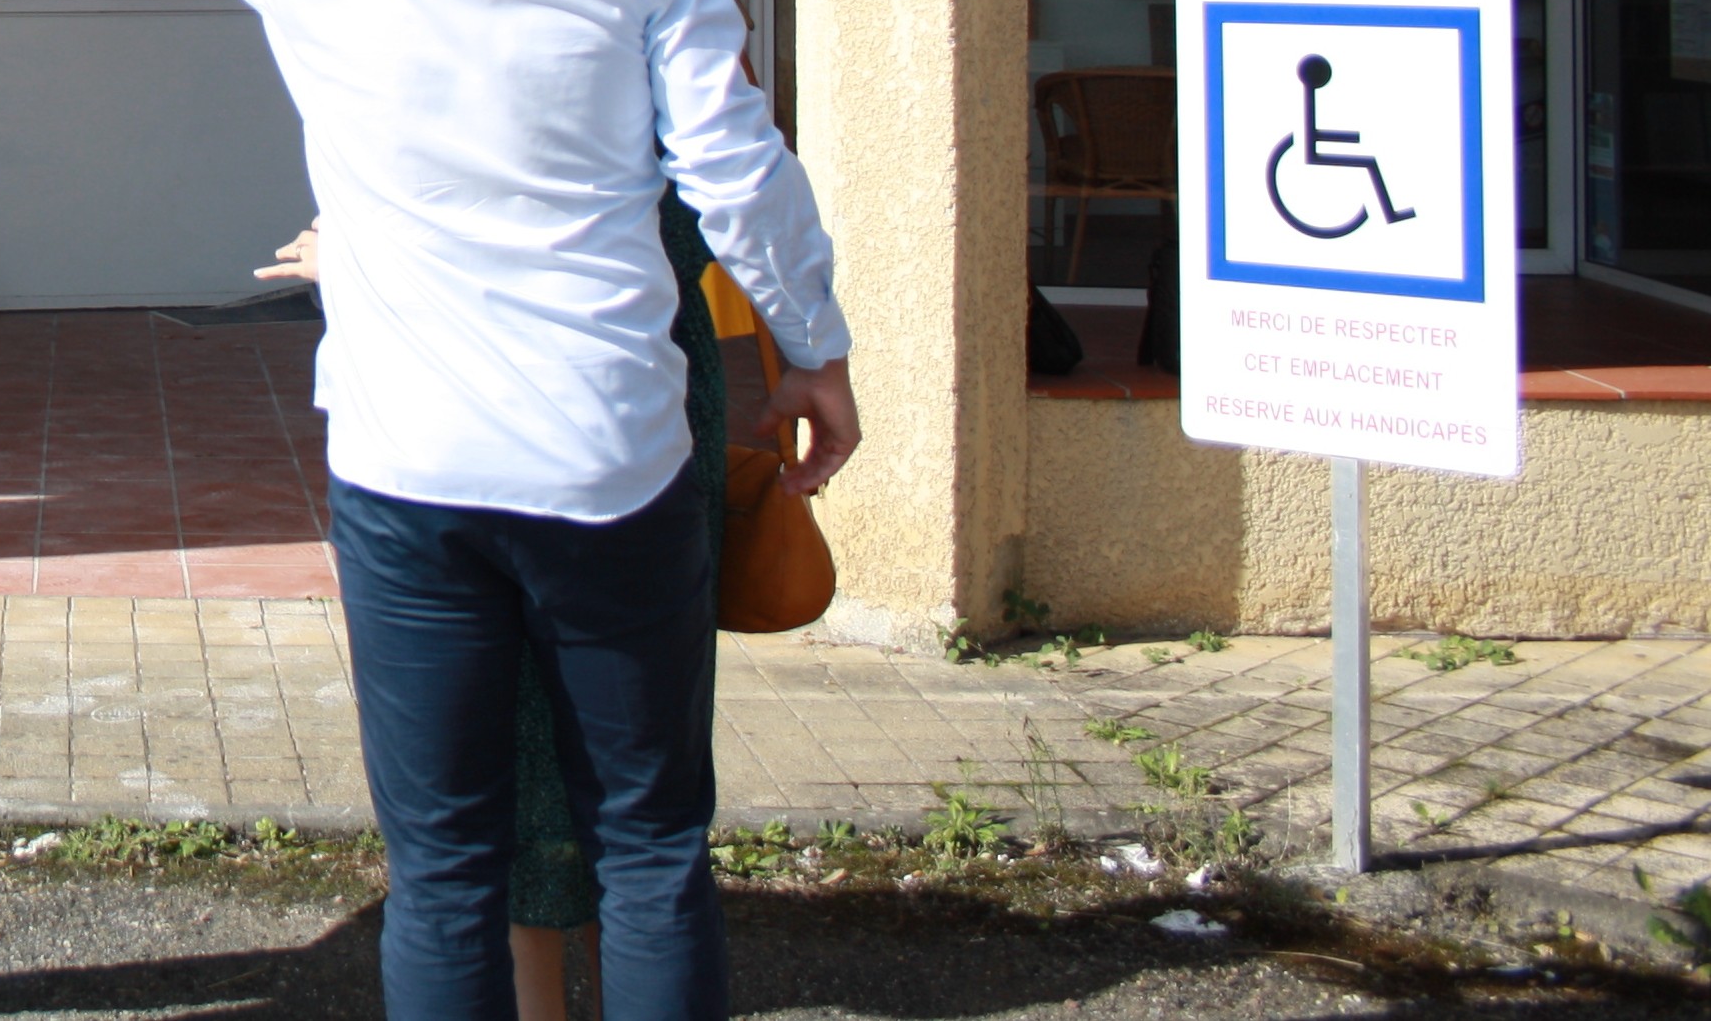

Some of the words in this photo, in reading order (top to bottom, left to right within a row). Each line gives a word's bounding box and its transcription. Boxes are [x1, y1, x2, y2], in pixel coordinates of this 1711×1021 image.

[1230, 309, 1291, 332] MERCI
[1300, 315, 1326, 335] DE
[1334, 318, 1458, 348] RESPECTER
[1244, 353, 1282, 374] CET
[1290, 357, 1443, 391] EMPLACEMENT
[1206, 394, 1294, 422] RÉSERVÉ
[1302, 406, 1343, 428] AUX
[1351, 413, 1487, 445] HANDICAPÉS
